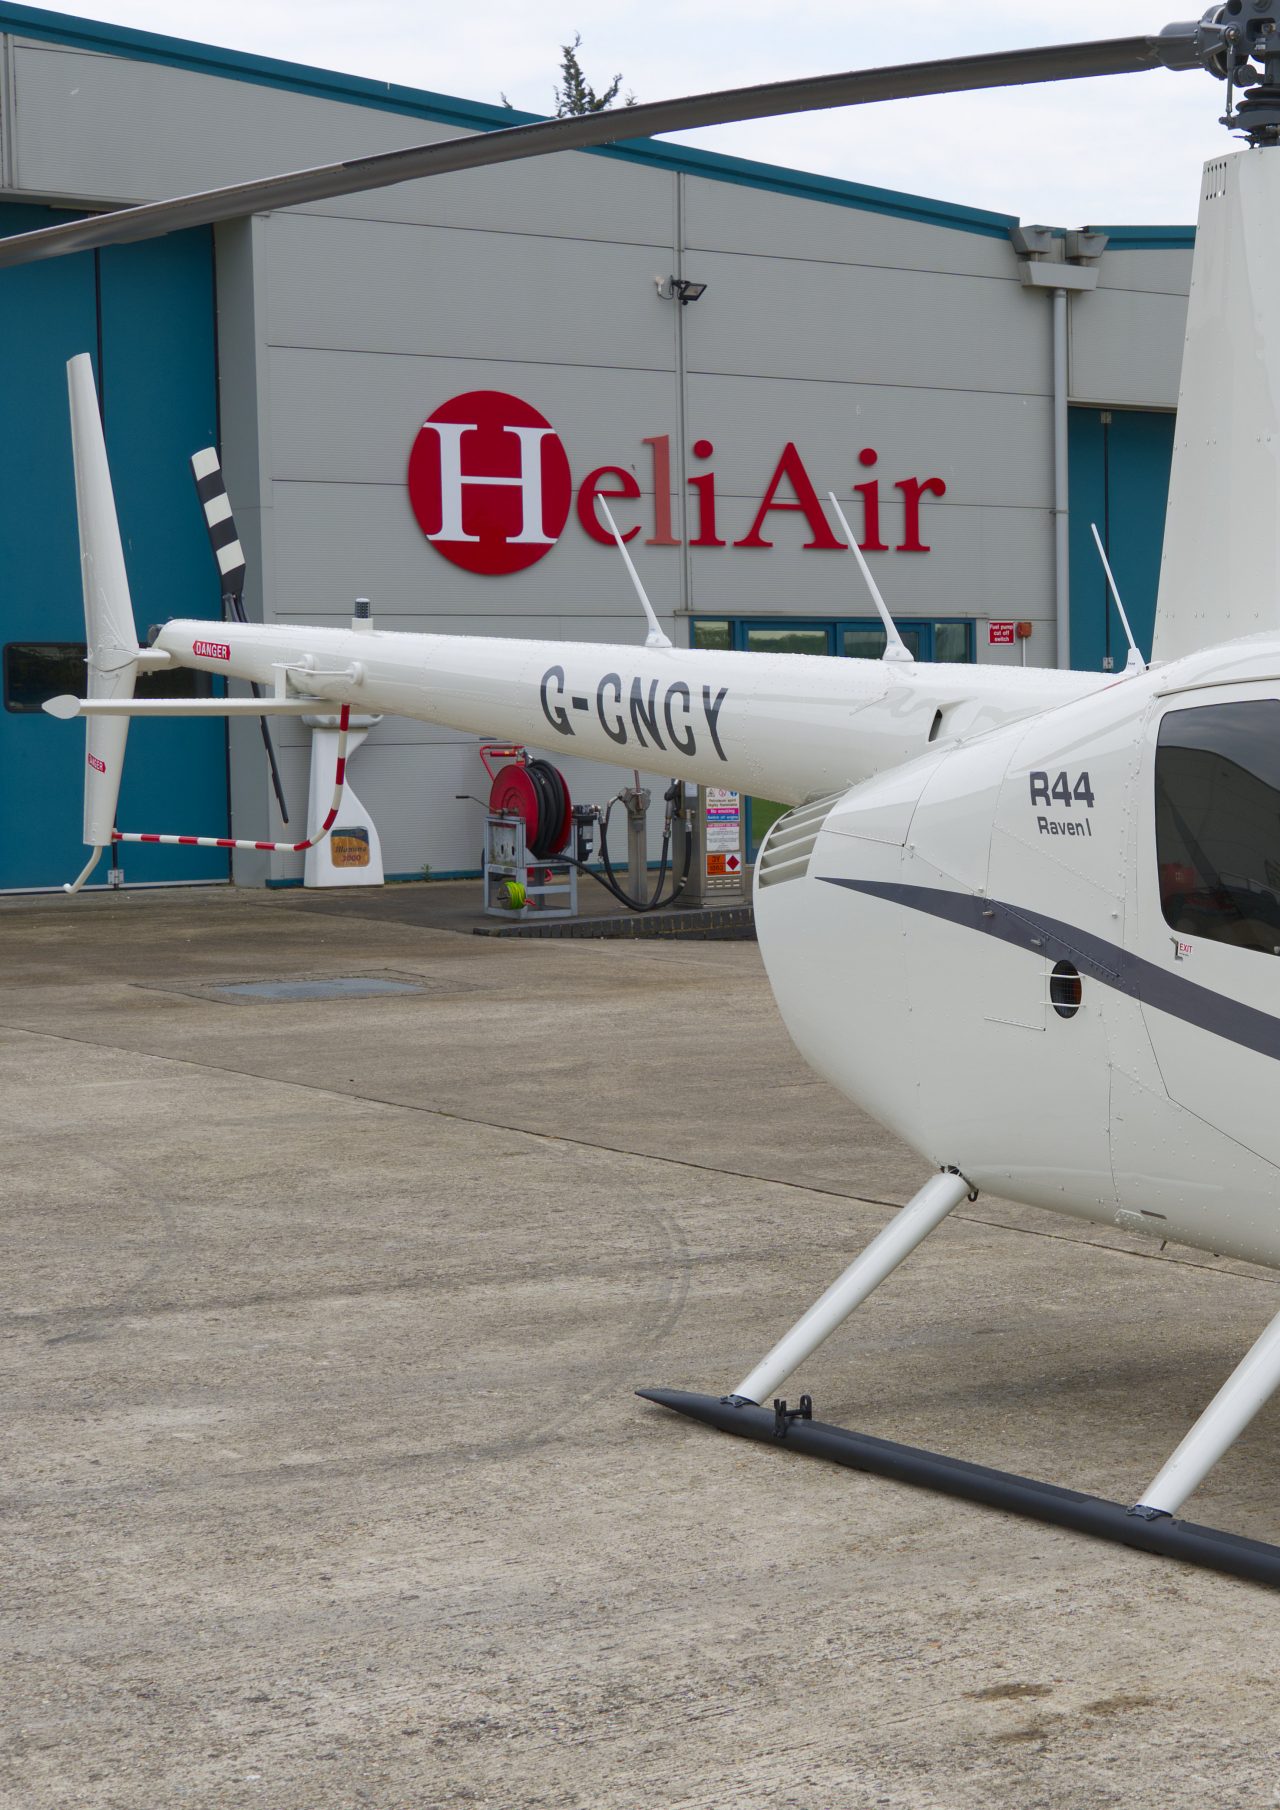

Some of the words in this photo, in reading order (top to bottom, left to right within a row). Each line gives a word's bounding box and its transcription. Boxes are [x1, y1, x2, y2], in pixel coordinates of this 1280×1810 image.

[422, 420, 946, 552] HeliAir
[195, 642, 228, 660] DANGER
[540, 665, 729, 762] G-CNCY
[88, 755, 104, 771] DANGER
[1029, 771, 1095, 808] R44
[1037, 816, 1085, 836] Raven
[1179, 943, 1193, 953] EXIT
